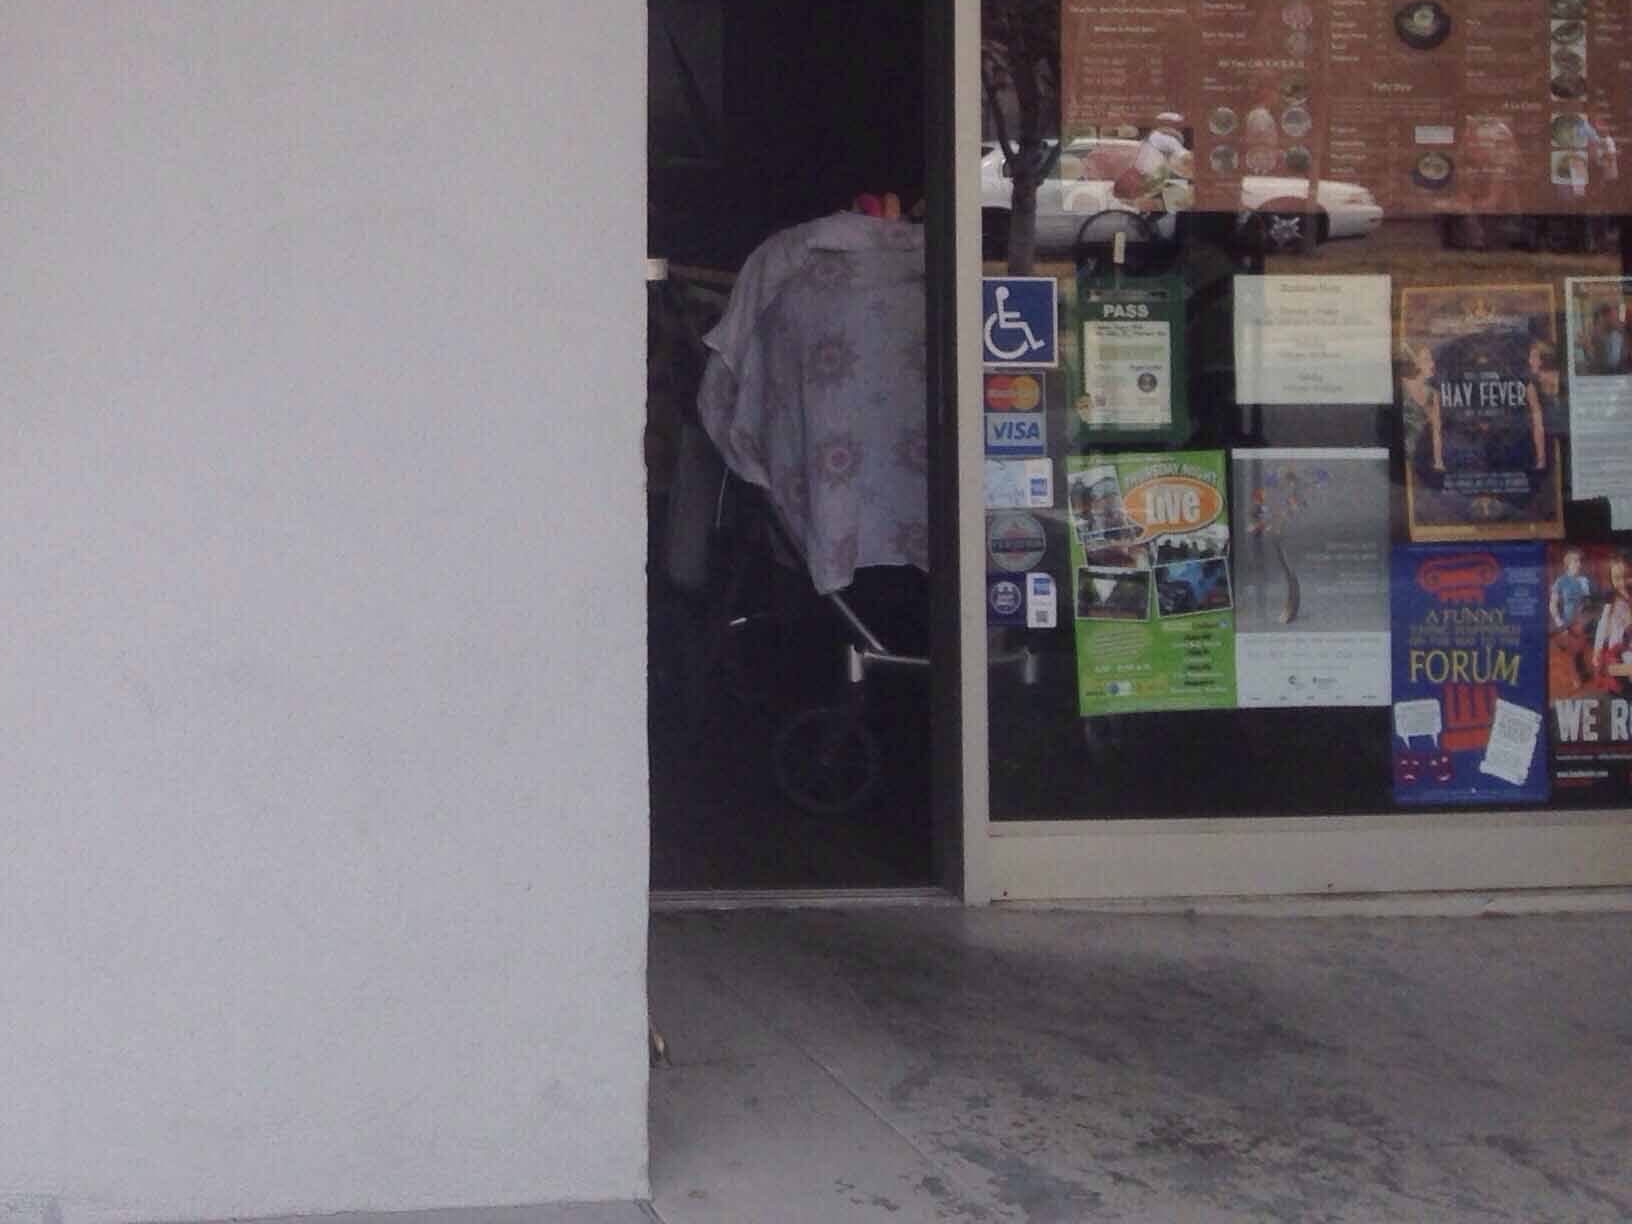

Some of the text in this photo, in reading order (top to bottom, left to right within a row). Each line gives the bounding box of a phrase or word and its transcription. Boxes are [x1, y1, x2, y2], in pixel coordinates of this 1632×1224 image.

[1103, 303, 1149, 318] PASS
[1441, 381, 1527, 407] HAY FEVER
[993, 422, 1039, 440] VISA
[1409, 646, 1521, 686] FORUM
[1555, 698, 1632, 742] WE R
